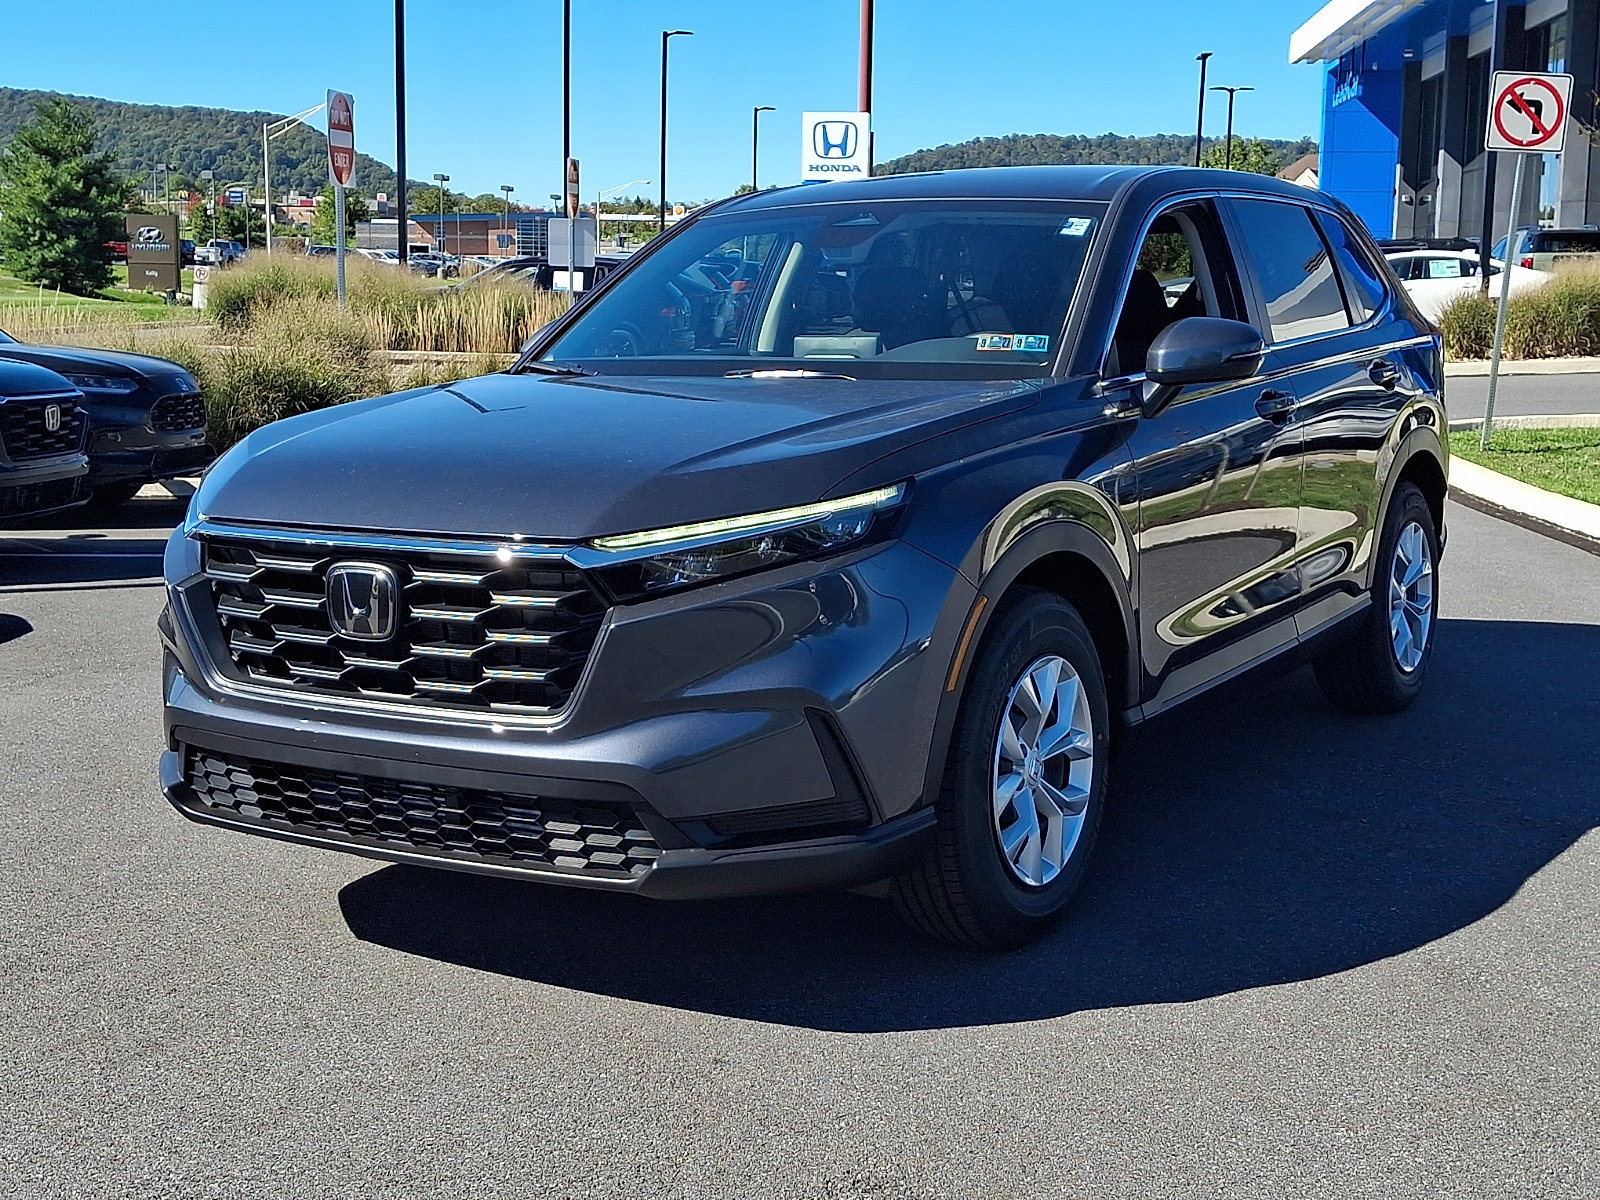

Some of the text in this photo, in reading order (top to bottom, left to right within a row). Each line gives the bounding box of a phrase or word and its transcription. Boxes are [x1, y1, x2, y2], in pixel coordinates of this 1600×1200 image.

[340, 110, 350, 126] NOT
[334, 152, 350, 168] ENTER
[808, 164, 862, 172] HONDA
[131, 243, 170, 252] HYUNDAI
[980, 337, 1011, 349] 9 27
[1016, 337, 1047, 349] 9 27
